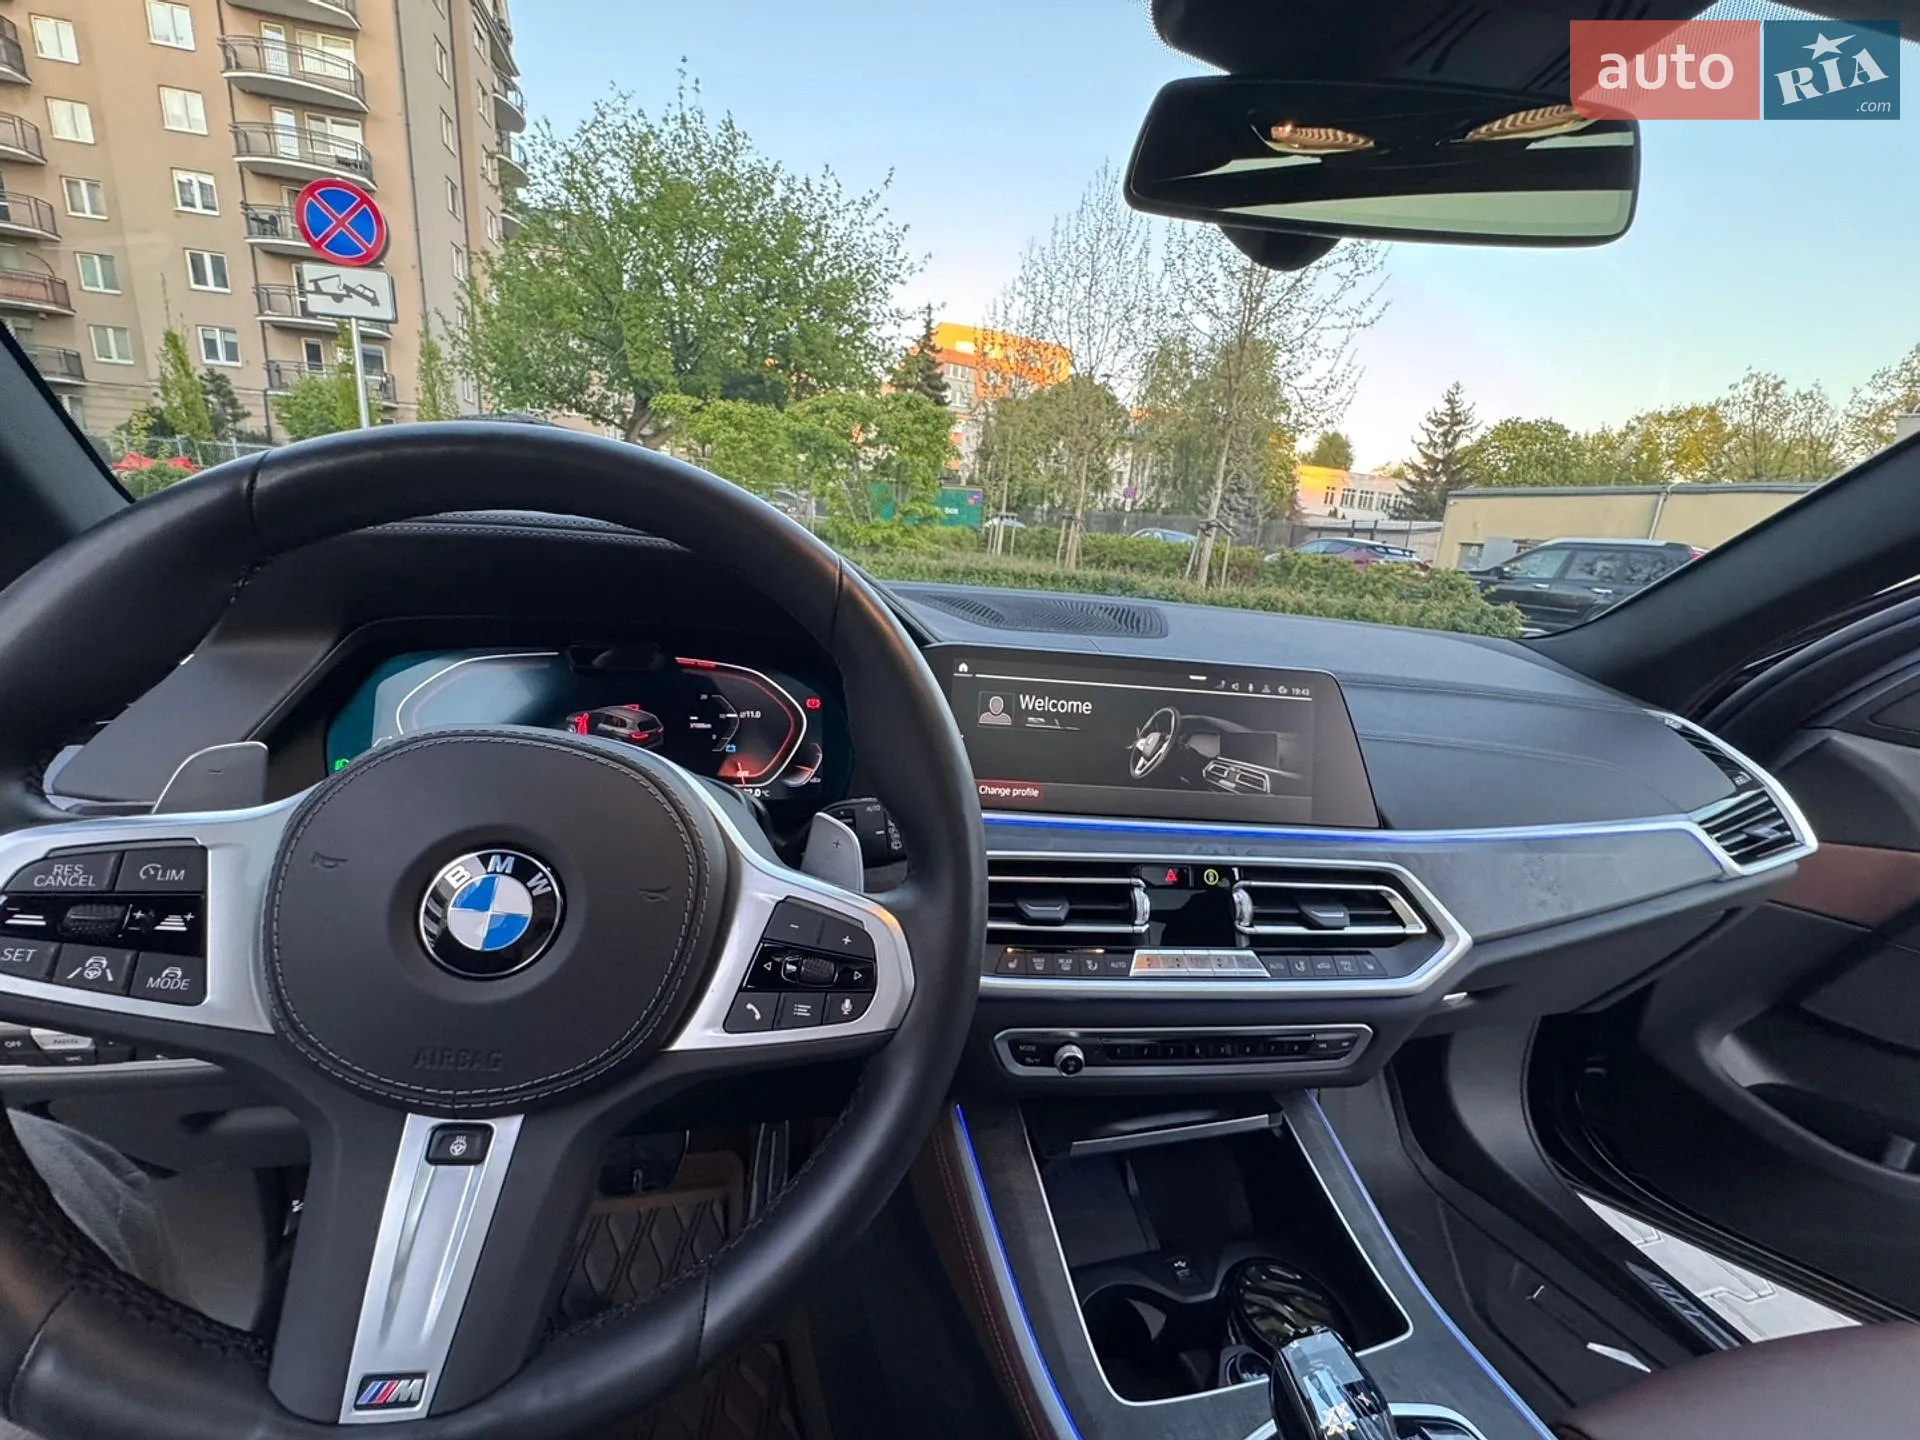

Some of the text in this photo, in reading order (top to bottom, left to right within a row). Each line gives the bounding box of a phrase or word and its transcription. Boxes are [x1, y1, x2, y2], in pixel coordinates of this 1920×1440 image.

[1019, 694, 1093, 715] Welcome
[978, 785, 1040, 798] Change profile
[52, 864, 84, 877] RES
[157, 869, 186, 882] LIM
[444, 854, 552, 897] BMW
[33, 874, 97, 888] CANCEL
[0, 947, 38, 963] SET
[145, 976, 192, 991] MODE
[412, 1047, 504, 1072] AIRBAG
